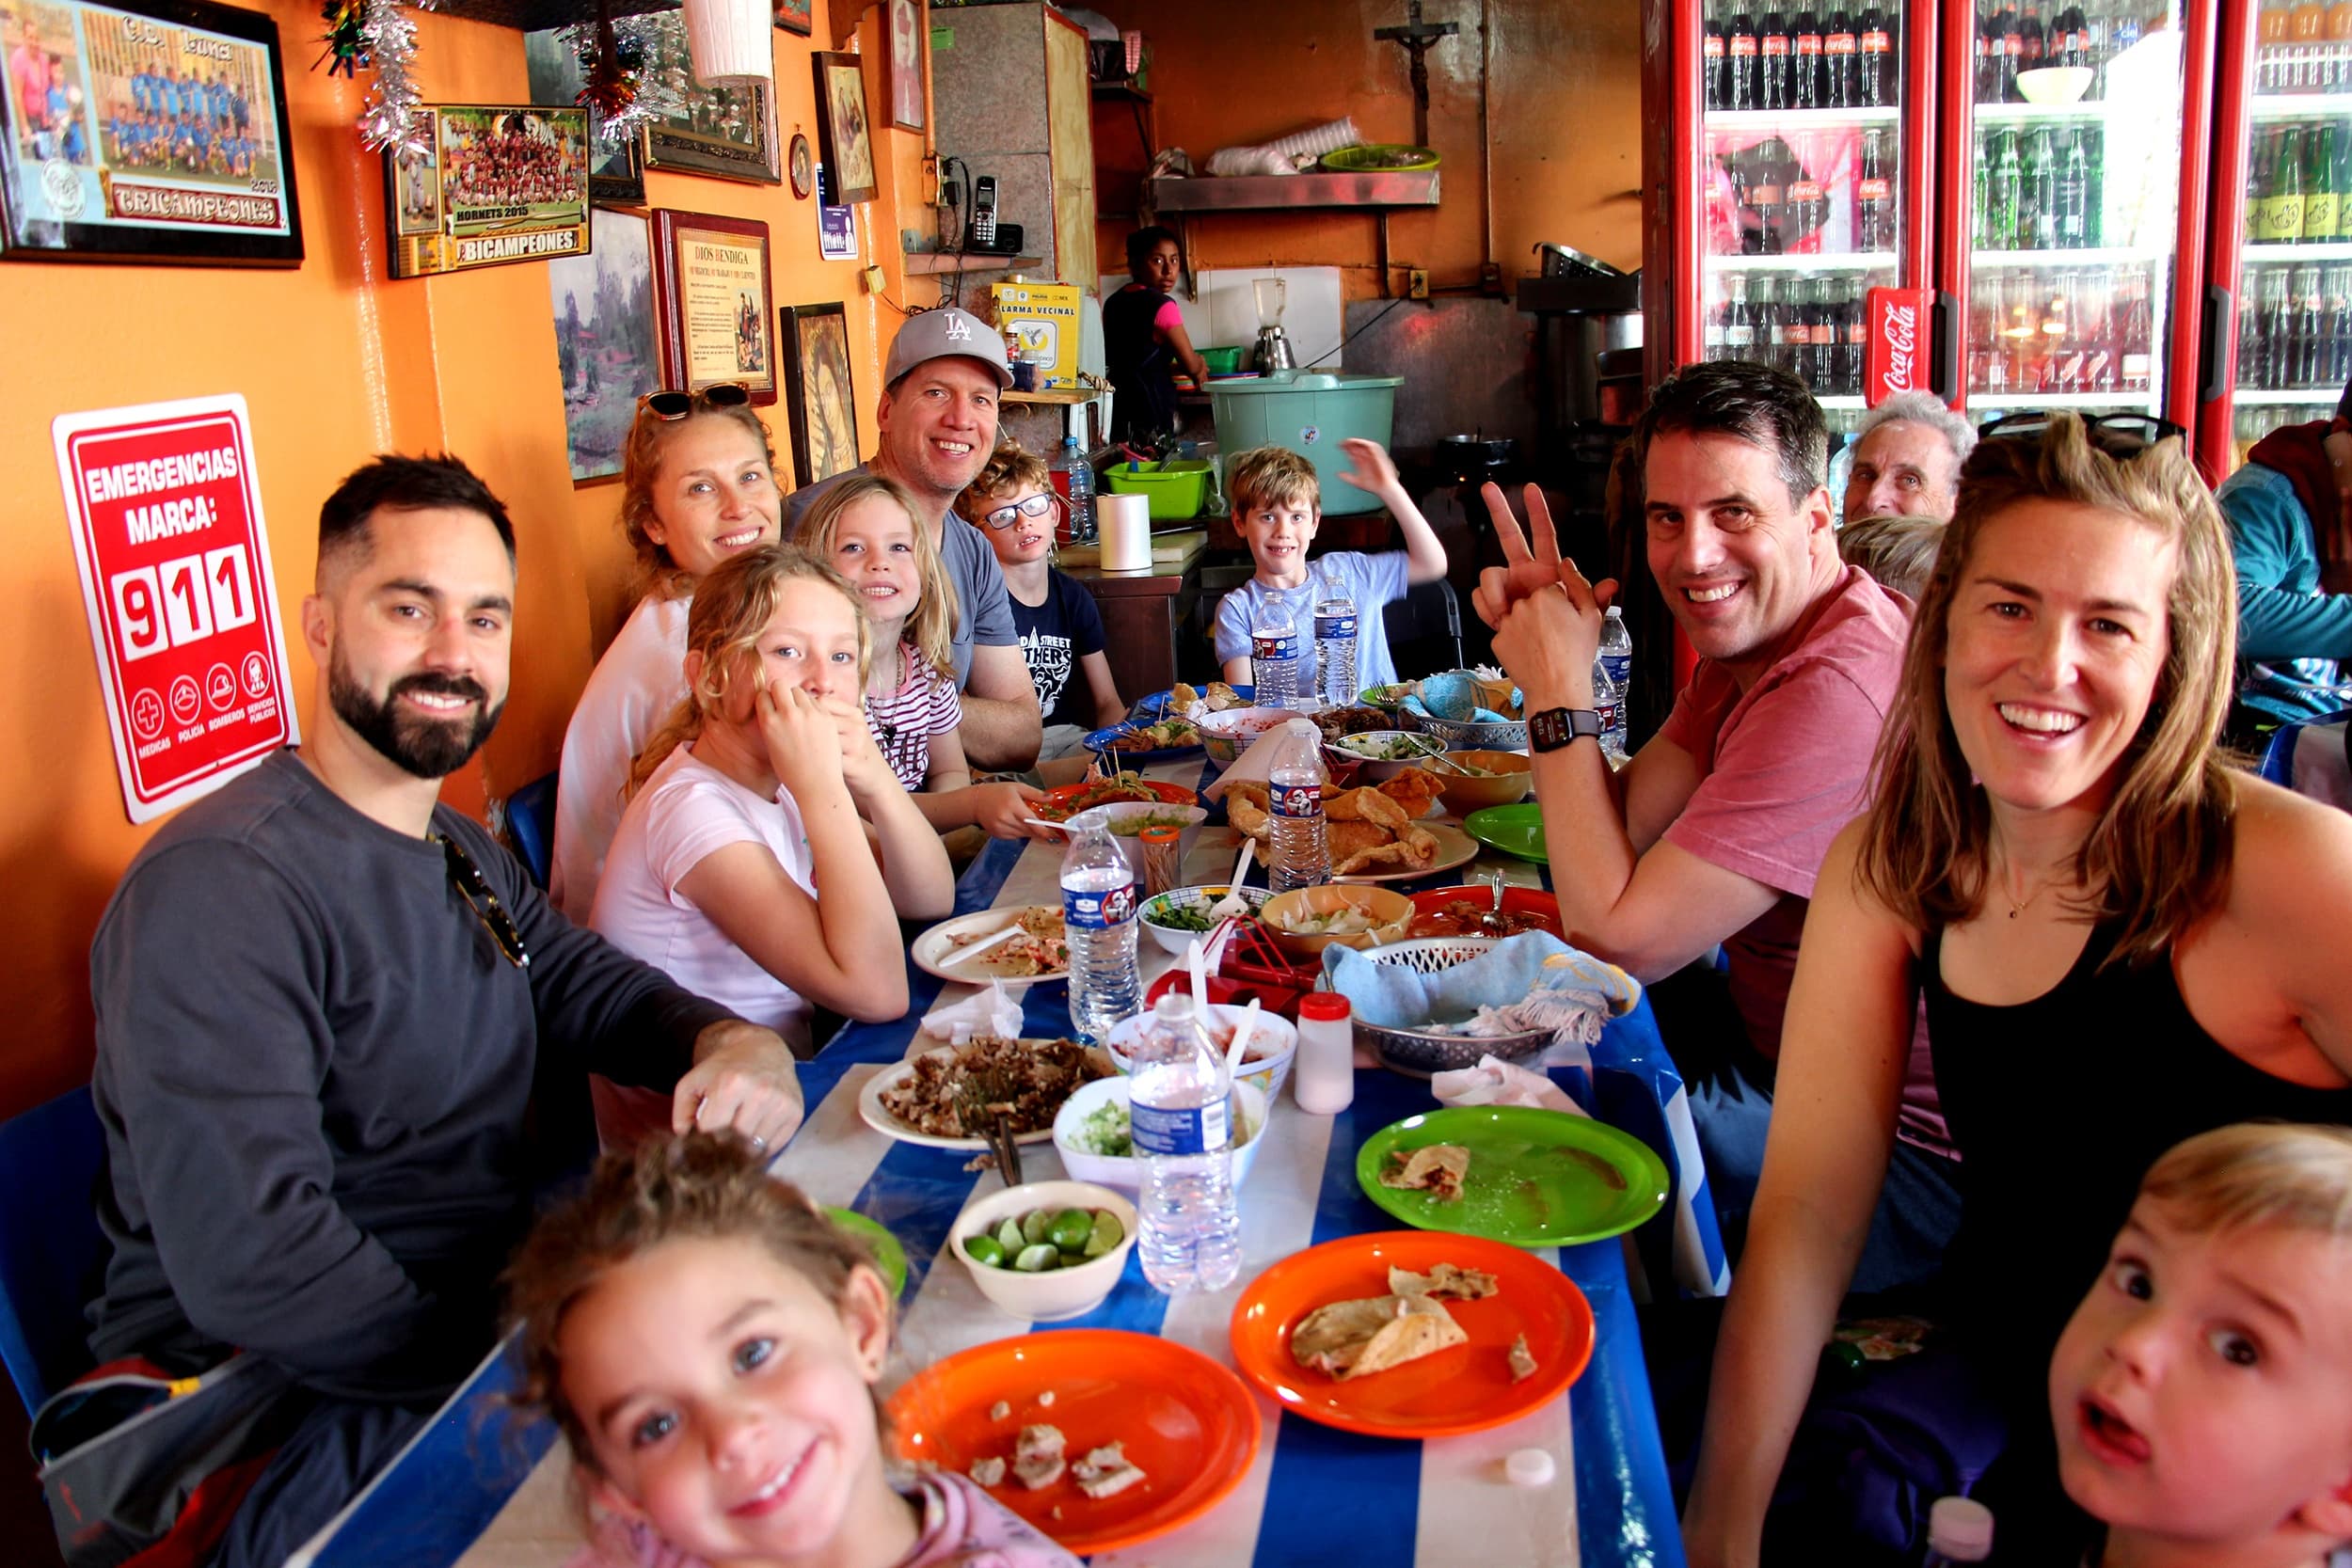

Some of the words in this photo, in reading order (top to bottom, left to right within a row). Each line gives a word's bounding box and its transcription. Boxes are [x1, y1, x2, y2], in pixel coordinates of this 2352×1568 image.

[116, 189, 276, 225] TRICAMPEONES
[456, 208, 503, 222] HORNETS
[505, 206, 529, 217] 2015
[465, 231, 574, 261] BICAMPEONES
[695, 246, 714, 261] DIOS
[715, 248, 749, 264] BENDIGA
[1037, 307, 1075, 315] VECINAL
[944, 312, 972, 341] LA
[1883, 301, 1915, 393] Coca-Cola
[86, 447, 238, 504] EMERGENCIAS
[125, 497, 217, 546] MARCA:
[122, 554, 245, 648] 911
[1041, 635, 1071, 648] STREET
[1024, 648, 1072, 666] THERS
[208, 708, 246, 732] BOMBEROS
